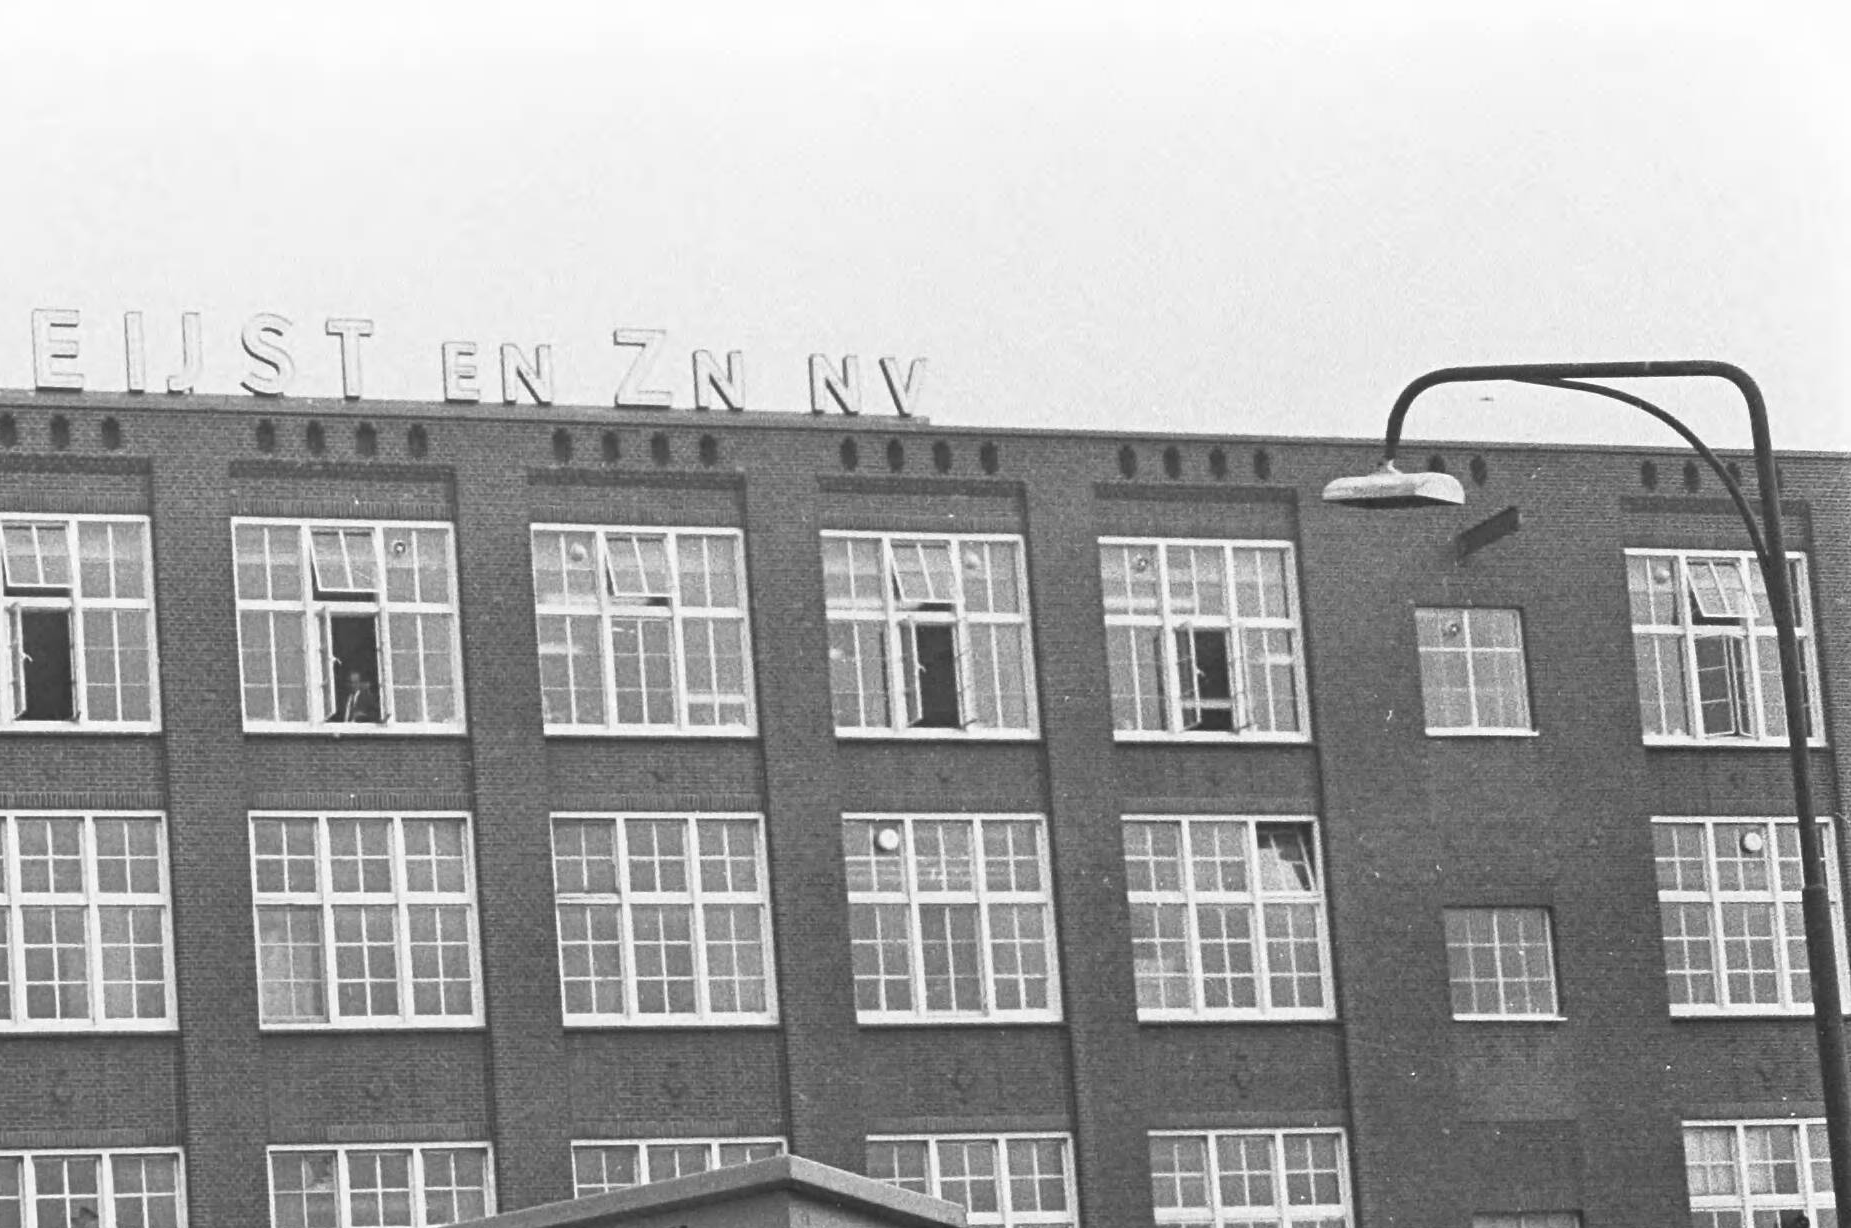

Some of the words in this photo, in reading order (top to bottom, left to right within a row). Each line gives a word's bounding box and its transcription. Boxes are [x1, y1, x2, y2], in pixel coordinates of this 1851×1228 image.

[441, 340, 552, 406] EN
[613, 328, 746, 412] ZN
[807, 352, 929, 418] NV
